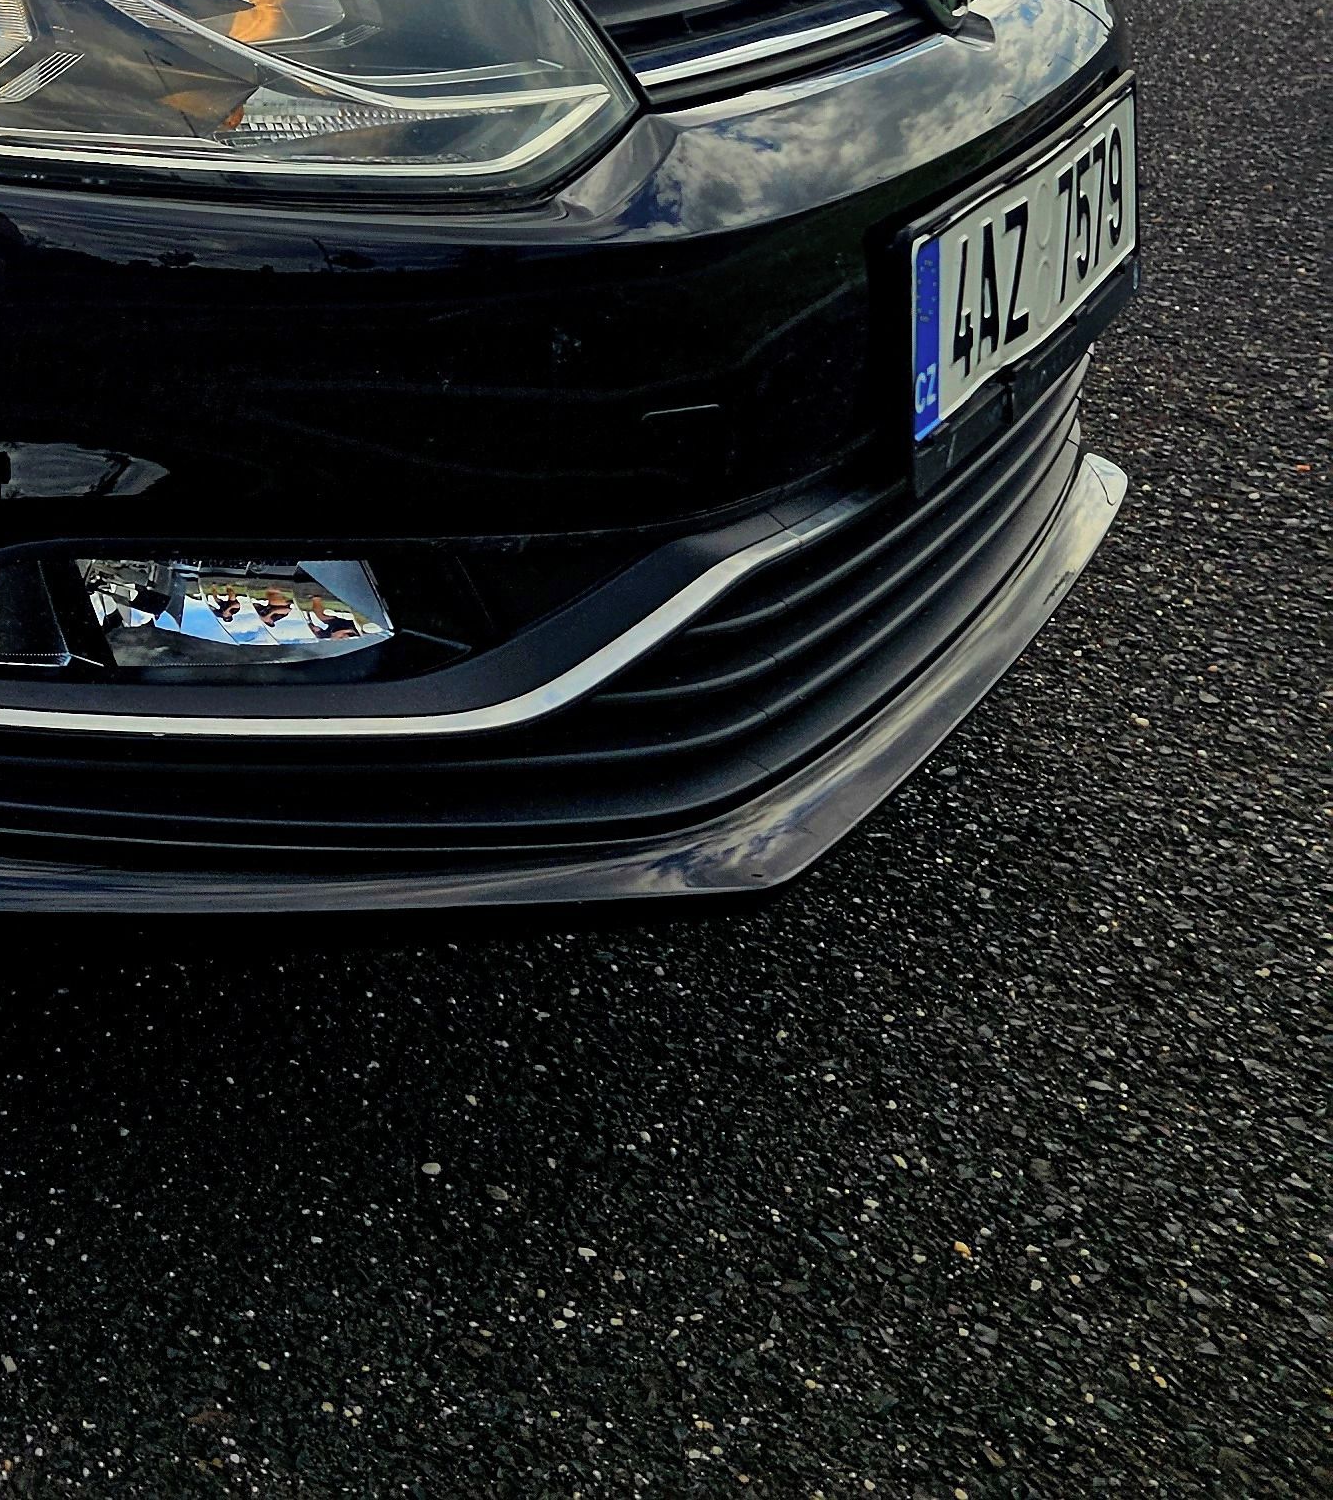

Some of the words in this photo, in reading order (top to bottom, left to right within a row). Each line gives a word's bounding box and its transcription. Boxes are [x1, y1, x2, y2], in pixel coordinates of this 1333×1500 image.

[950, 195, 1029, 378] 4AZ
[1056, 123, 1124, 305] 7579
[914, 363, 938, 415] CZ
